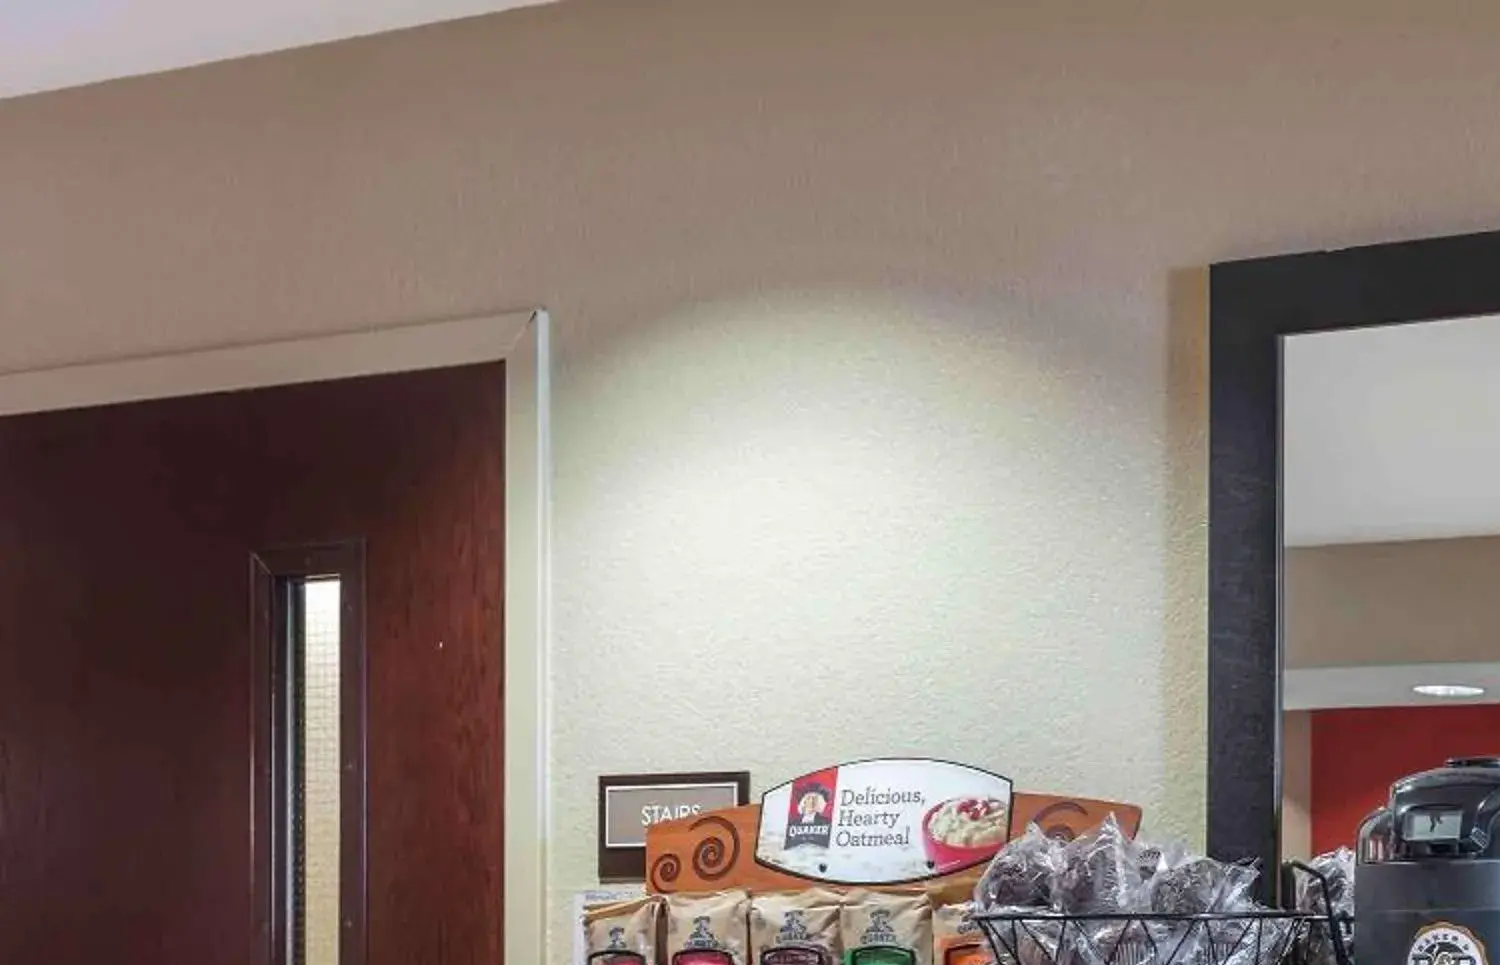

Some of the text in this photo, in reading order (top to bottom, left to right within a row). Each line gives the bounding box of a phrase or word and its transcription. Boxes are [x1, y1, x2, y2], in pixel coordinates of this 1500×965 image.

[841, 786, 925, 806] Delicious,
[838, 809, 900, 829] Hearty
[789, 824, 829, 837] QUAKER
[836, 825, 910, 848] Oatmeal
